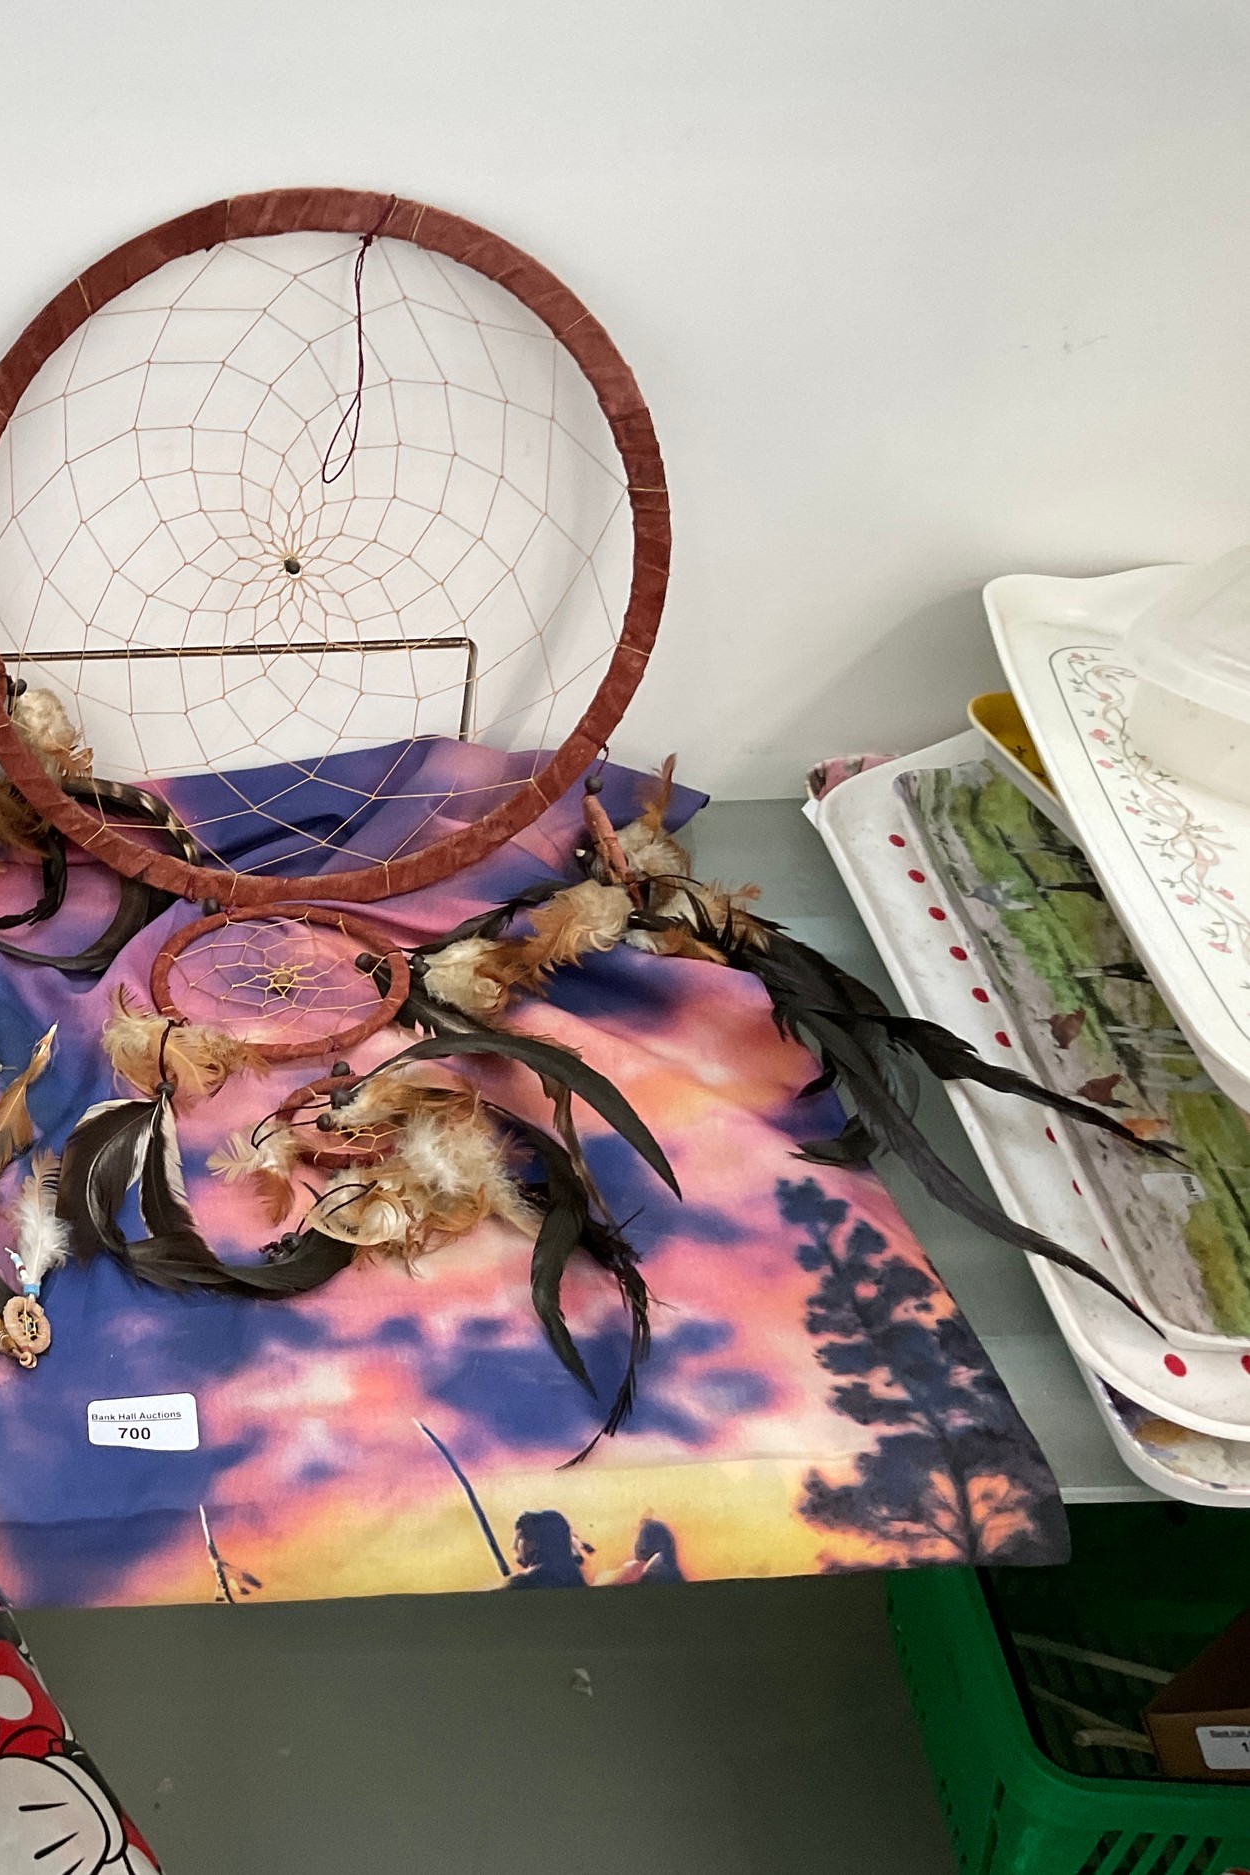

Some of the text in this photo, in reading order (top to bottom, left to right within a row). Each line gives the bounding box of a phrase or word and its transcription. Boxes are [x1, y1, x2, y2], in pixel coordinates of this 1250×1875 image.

[91, 1410, 182, 1421] Bank Hall Auctions
[117, 1427, 151, 1440] 700
